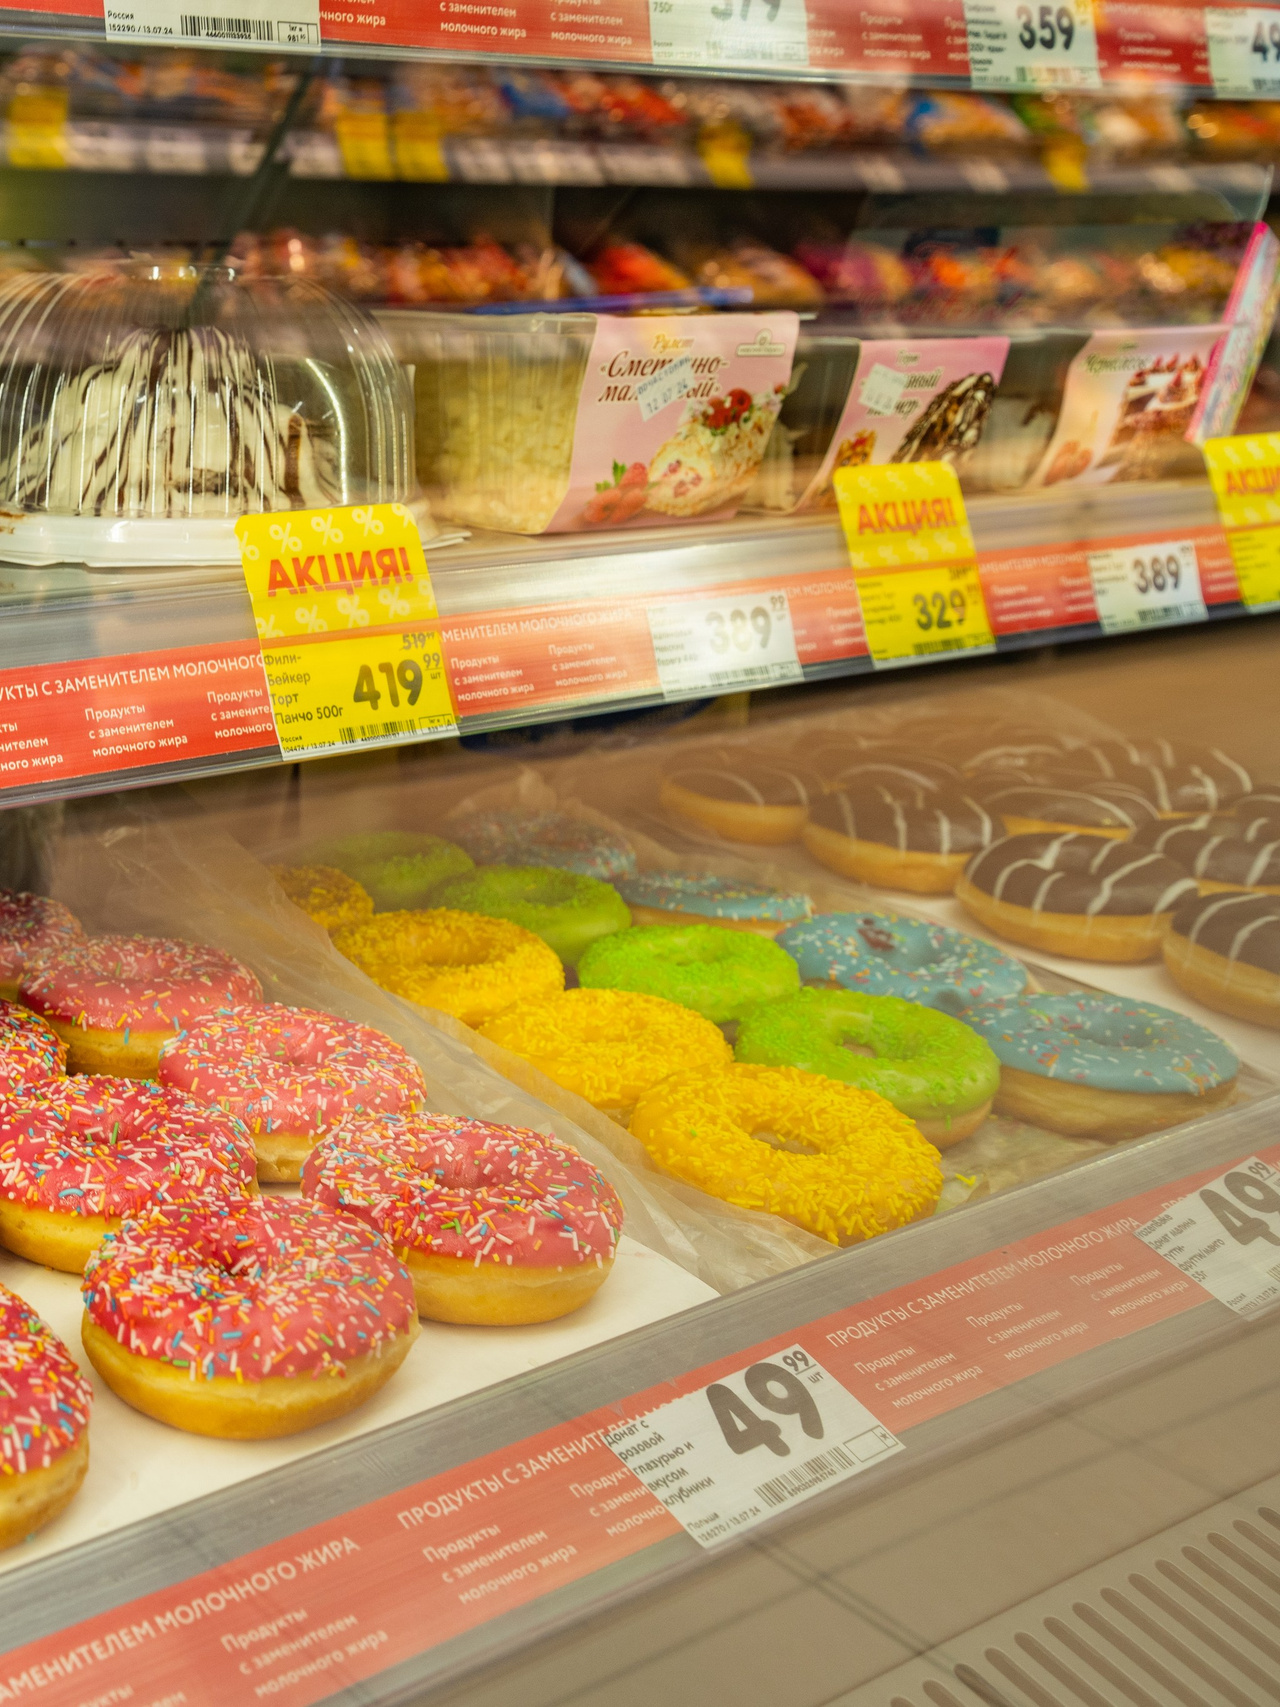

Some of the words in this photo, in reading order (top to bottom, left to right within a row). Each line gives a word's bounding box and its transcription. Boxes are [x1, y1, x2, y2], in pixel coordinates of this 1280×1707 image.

[107, 10, 134, 20] Россия
[1016, 5, 1075, 50] 359
[143, 24, 173, 35] 13.07.24
[440, 20, 497, 37] молочного
[499, 26, 527, 40] жира
[857, 496, 958, 537] АКЦИЯ!
[268, 546, 414, 598] АКЦИЯ!
[1132, 554, 1182, 594] 389
[913, 589, 967, 631] 329
[705, 605, 773, 655] 389
[264, 653, 302, 666] Фили-
[450, 655, 499, 671] Продукты
[41, 680, 52, 695] С
[55, 666, 170, 694] ЗАМЕНИТЕЛЕМ
[267, 671, 311, 686] Бейкер
[353, 659, 423, 711] 419
[423, 652, 441, 670] 99
[430, 671, 441, 680] шт
[270, 693, 299, 707] Торт
[458, 688, 509, 702] молочного
[85, 702, 146, 722] Продукты
[273, 709, 313, 726] Панчо
[316, 705, 344, 721] 500г
[98, 717, 174, 739] заменителем
[280, 735, 303, 744] Россия
[92, 738, 156, 758] молочного
[158, 733, 188, 749] жира
[310, 740, 336, 750] 13.07.24
[31, 752, 64, 768] жира
[1199, 1170, 1280, 1247] 49
[1247, 1161, 1271, 1179] 99
[918, 1260, 1019, 1311] ЗАМЕНИТЕЛЕМ
[1191, 1269, 1208, 1283] 55г
[807, 1371, 824, 1384] шт
[705, 1361, 825, 1458] 49
[782, 1349, 810, 1373] 99
[891, 1374, 955, 1409] молочного
[605, 1421, 640, 1448] Донат
[618, 1430, 665, 1464] розовой
[633, 1443, 685, 1477] глазурью
[685, 1440, 695, 1451] и
[502, 1467, 520, 1485] С
[647, 1465, 690, 1493] вкусом
[663, 1475, 716, 1508] клубники
[730, 1505, 762, 1527] 13.07.24
[295, 1534, 361, 1574] ЖИРА
[422, 1522, 502, 1563] Продукты
[254, 1648, 345, 1699] молочного
